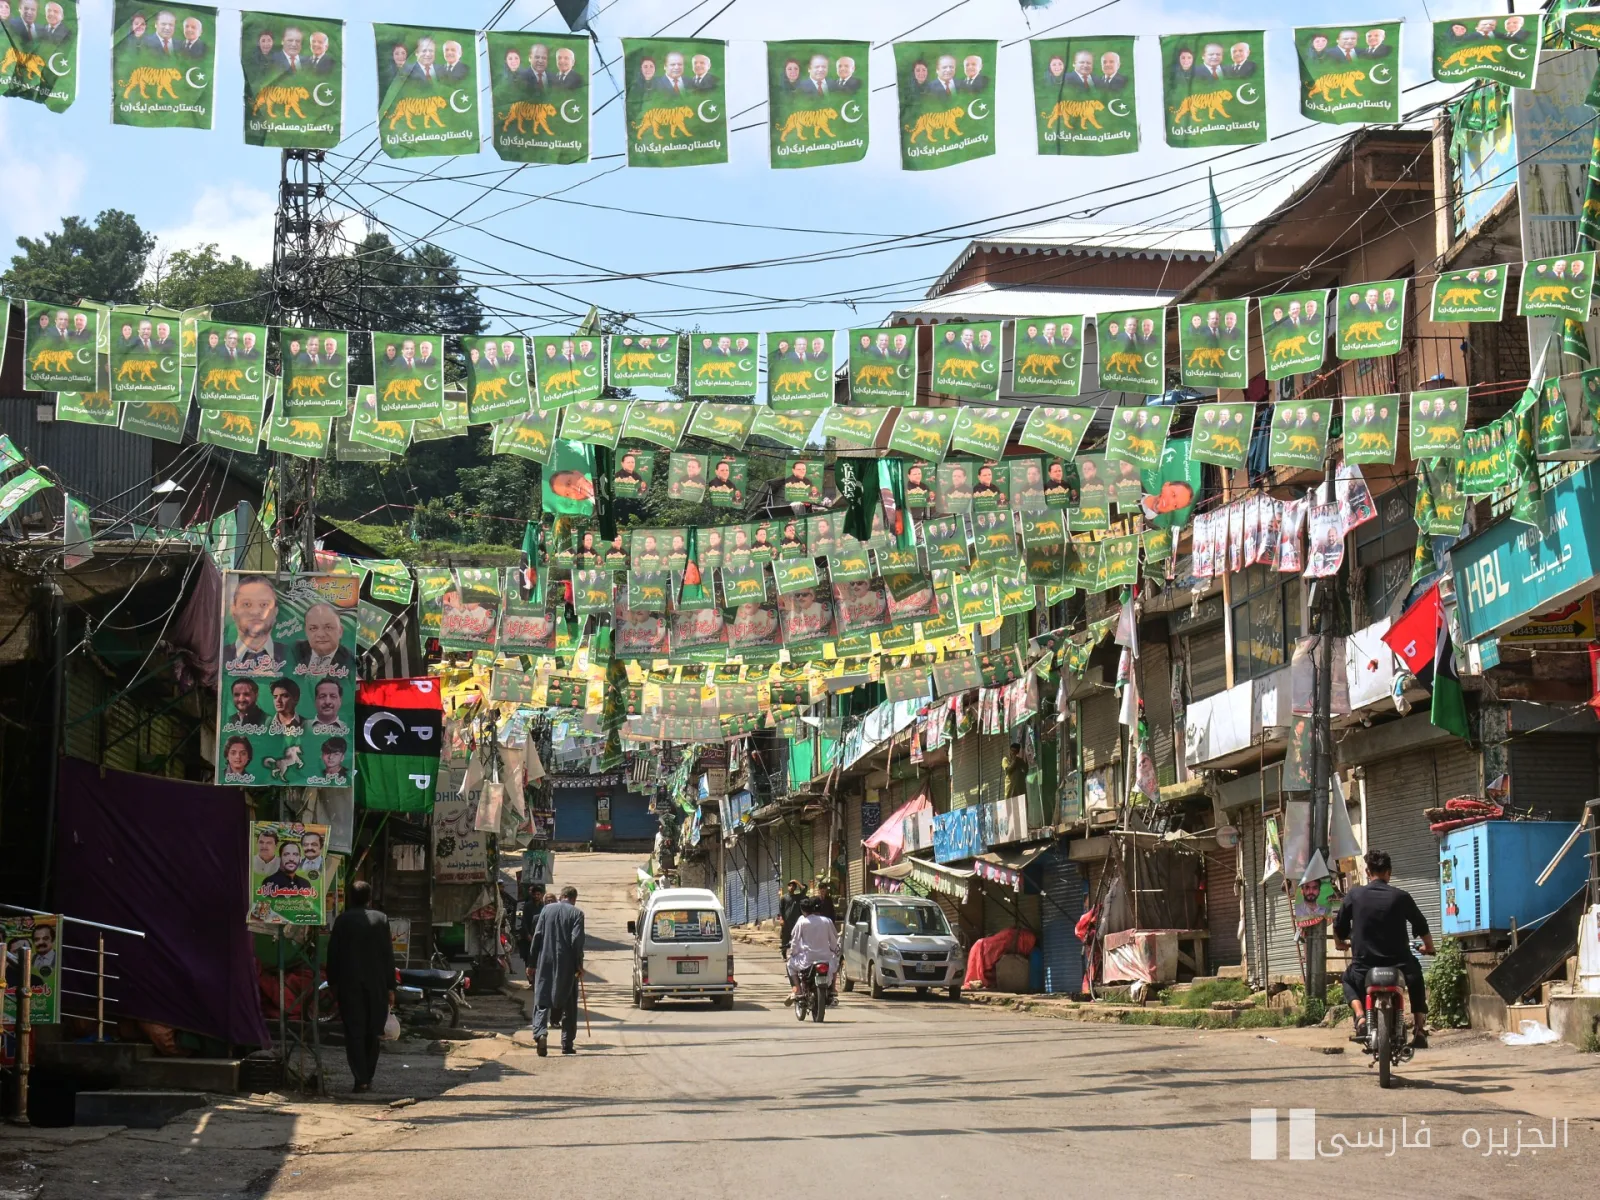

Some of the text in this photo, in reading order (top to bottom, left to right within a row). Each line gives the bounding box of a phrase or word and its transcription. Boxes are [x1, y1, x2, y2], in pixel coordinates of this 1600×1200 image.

[1492, 66, 1525, 79] پاکستان
[148, 104, 172, 113] مسلم
[173, 104, 205, 115] پاکستان
[1333, 103, 1357, 113] مسلم
[1358, 100, 1390, 109] پاکستان
[277, 123, 301, 132] مسلم
[301, 124, 333, 133] پاکستان
[1201, 124, 1225, 134] مسلم
[1225, 121, 1258, 131] پاکستان
[415, 133, 440, 143] مسلم
[440, 130, 473, 141] پاکستان
[1073, 134, 1097, 142] مسلم
[1097, 131, 1130, 142] پاکستان
[527, 139, 550, 149] مسلم
[550, 140, 581, 151] پاکستان
[688, 140, 721, 151] پاکستان
[830, 139, 863, 150] پاکستان
[957, 134, 988, 149] پاکستان
[663, 143, 687, 153] مسلم
[806, 144, 830, 153] مسلم
[934, 143, 957, 155] مسلم
[1561, 305, 1582, 314] پاکستان
[1550, 508, 1568, 535] ANK
[1465, 549, 1510, 613] HBL
[411, 726, 432, 740] P
[409, 774, 431, 790] P
[435, 791, 481, 802] DHIROT
[272, 885, 298, 898] فیصل
[299, 886, 318, 899] راجہ
